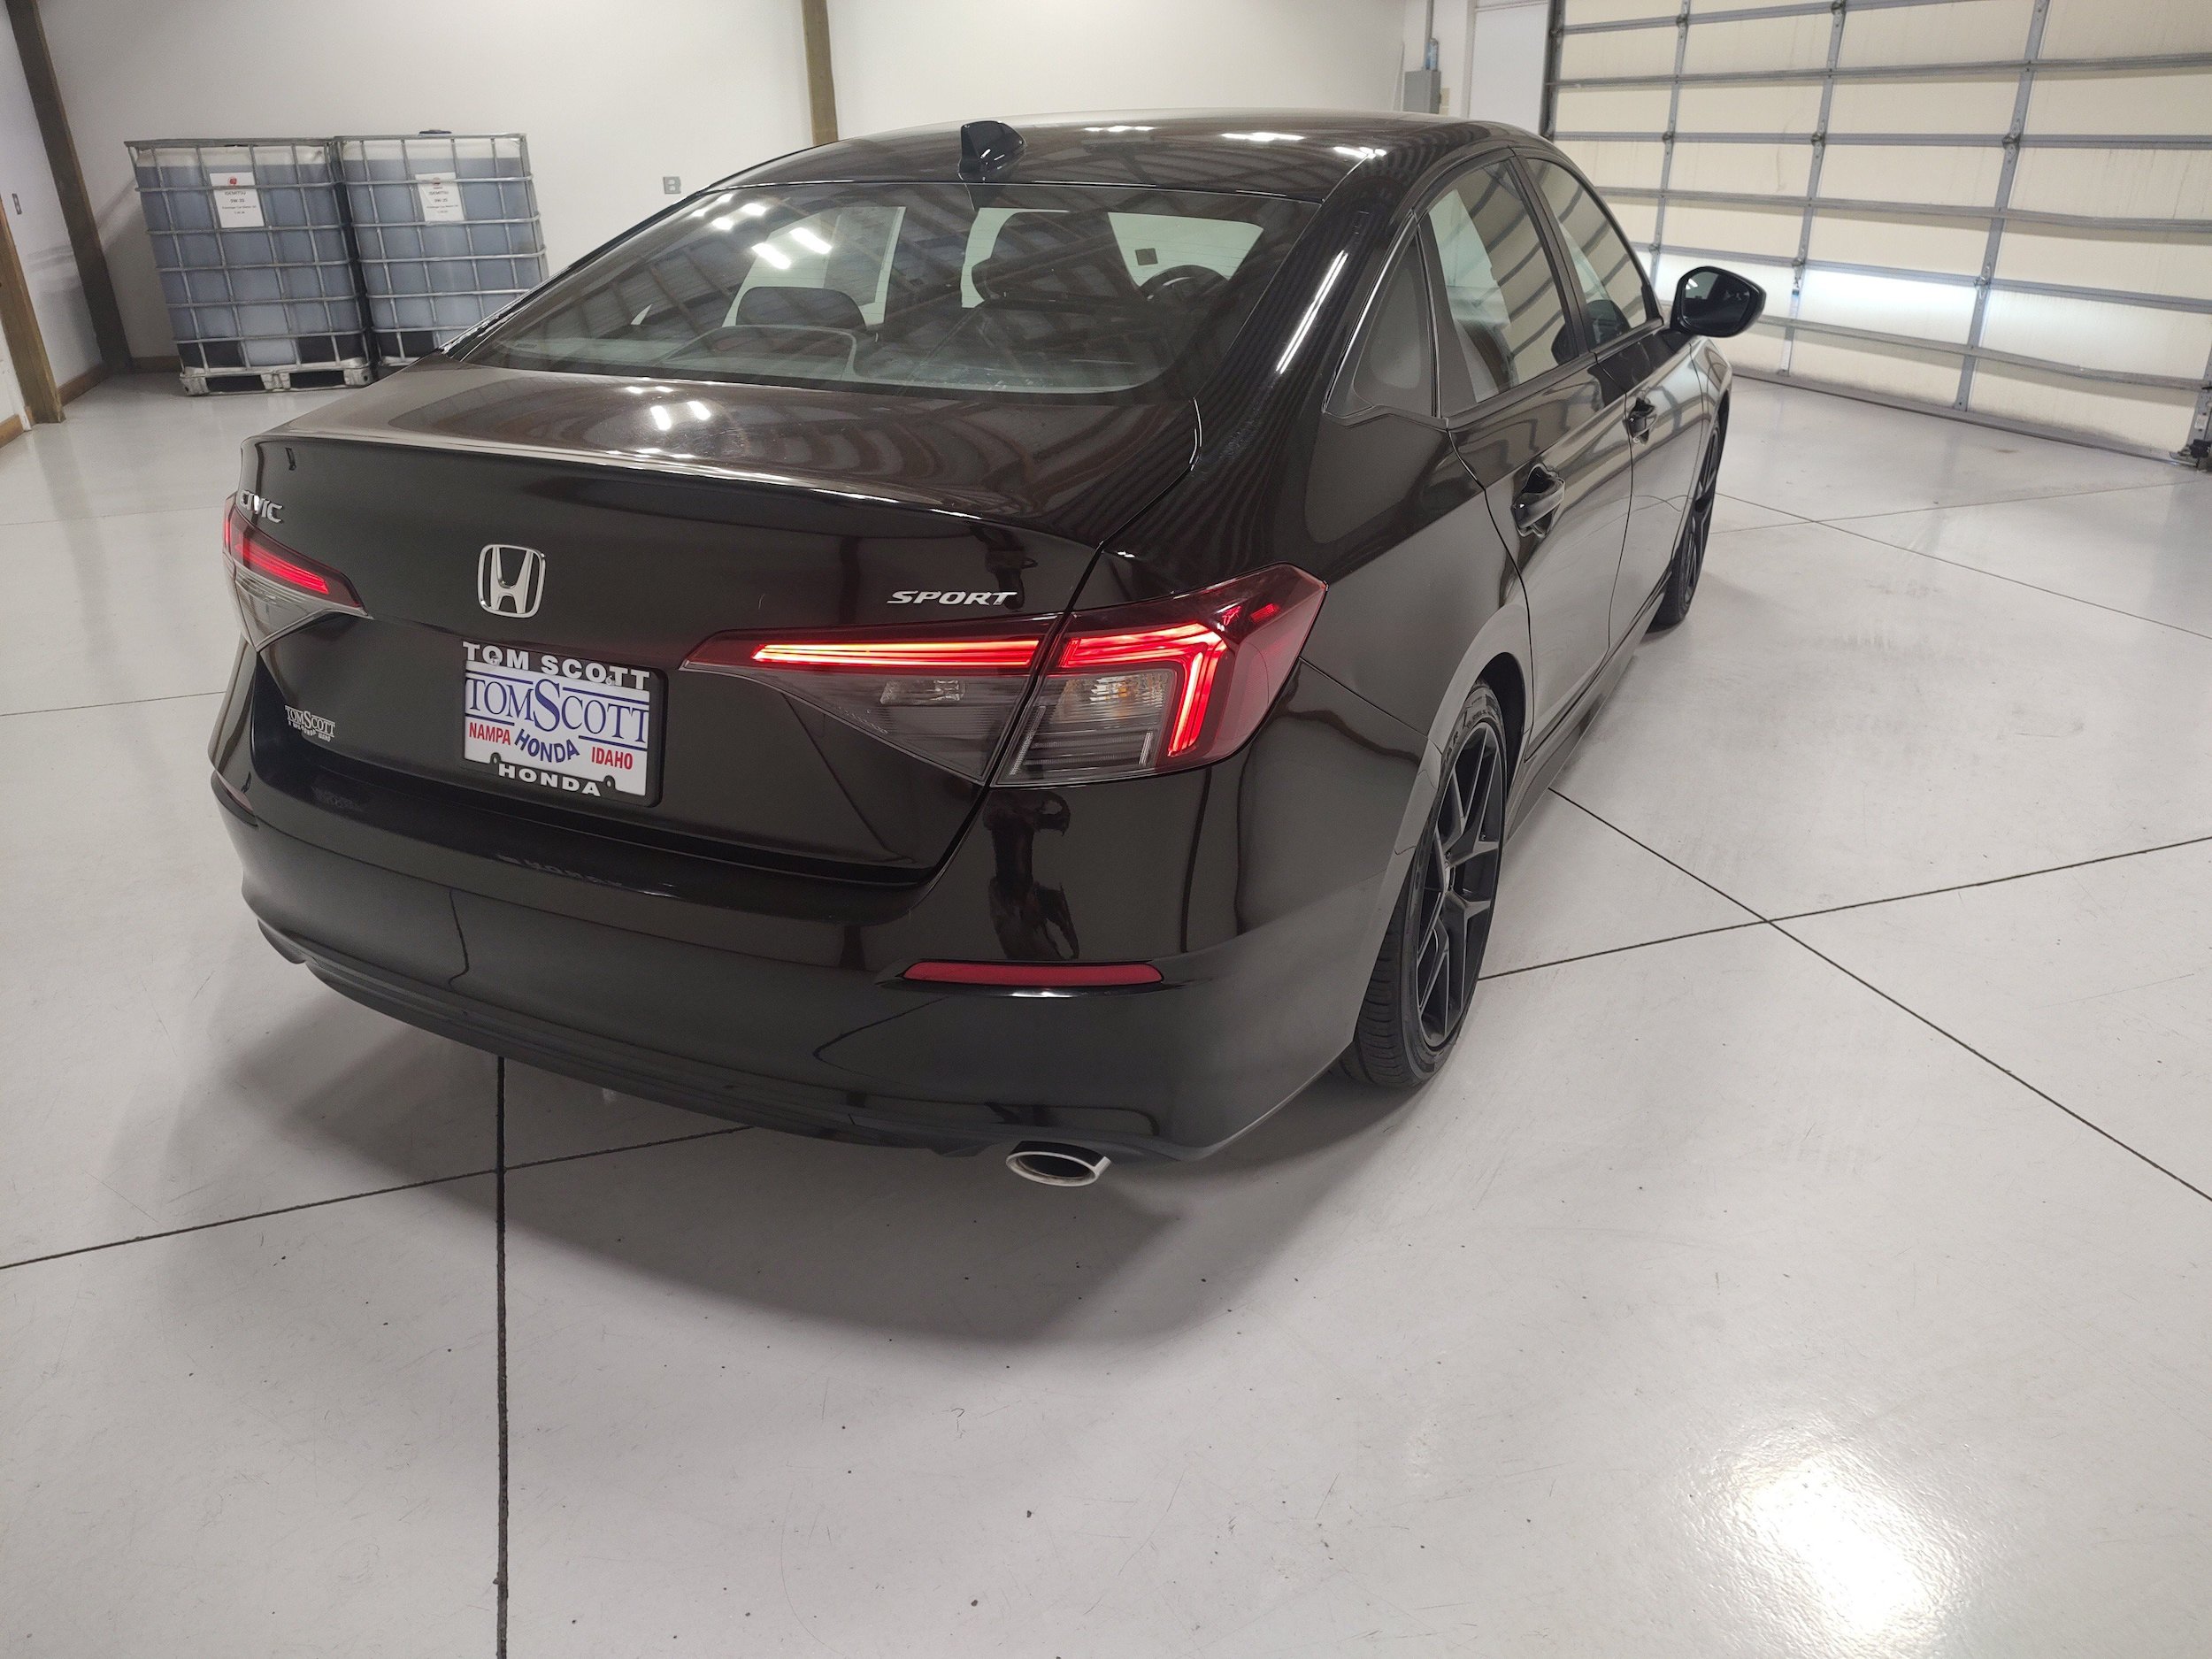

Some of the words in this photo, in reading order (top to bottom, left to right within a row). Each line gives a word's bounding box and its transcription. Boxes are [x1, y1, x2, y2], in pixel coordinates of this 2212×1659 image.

[240, 489, 283, 523] CIVIC
[887, 590, 1018, 606] SPORT
[463, 641, 529, 671] TOM
[541, 655, 650, 691] SCOTT
[469, 721, 511, 746] NAMPA
[514, 728, 580, 764] HONDA
[591, 746, 634, 771] IDAHO
[498, 763, 601, 796] HONDA
